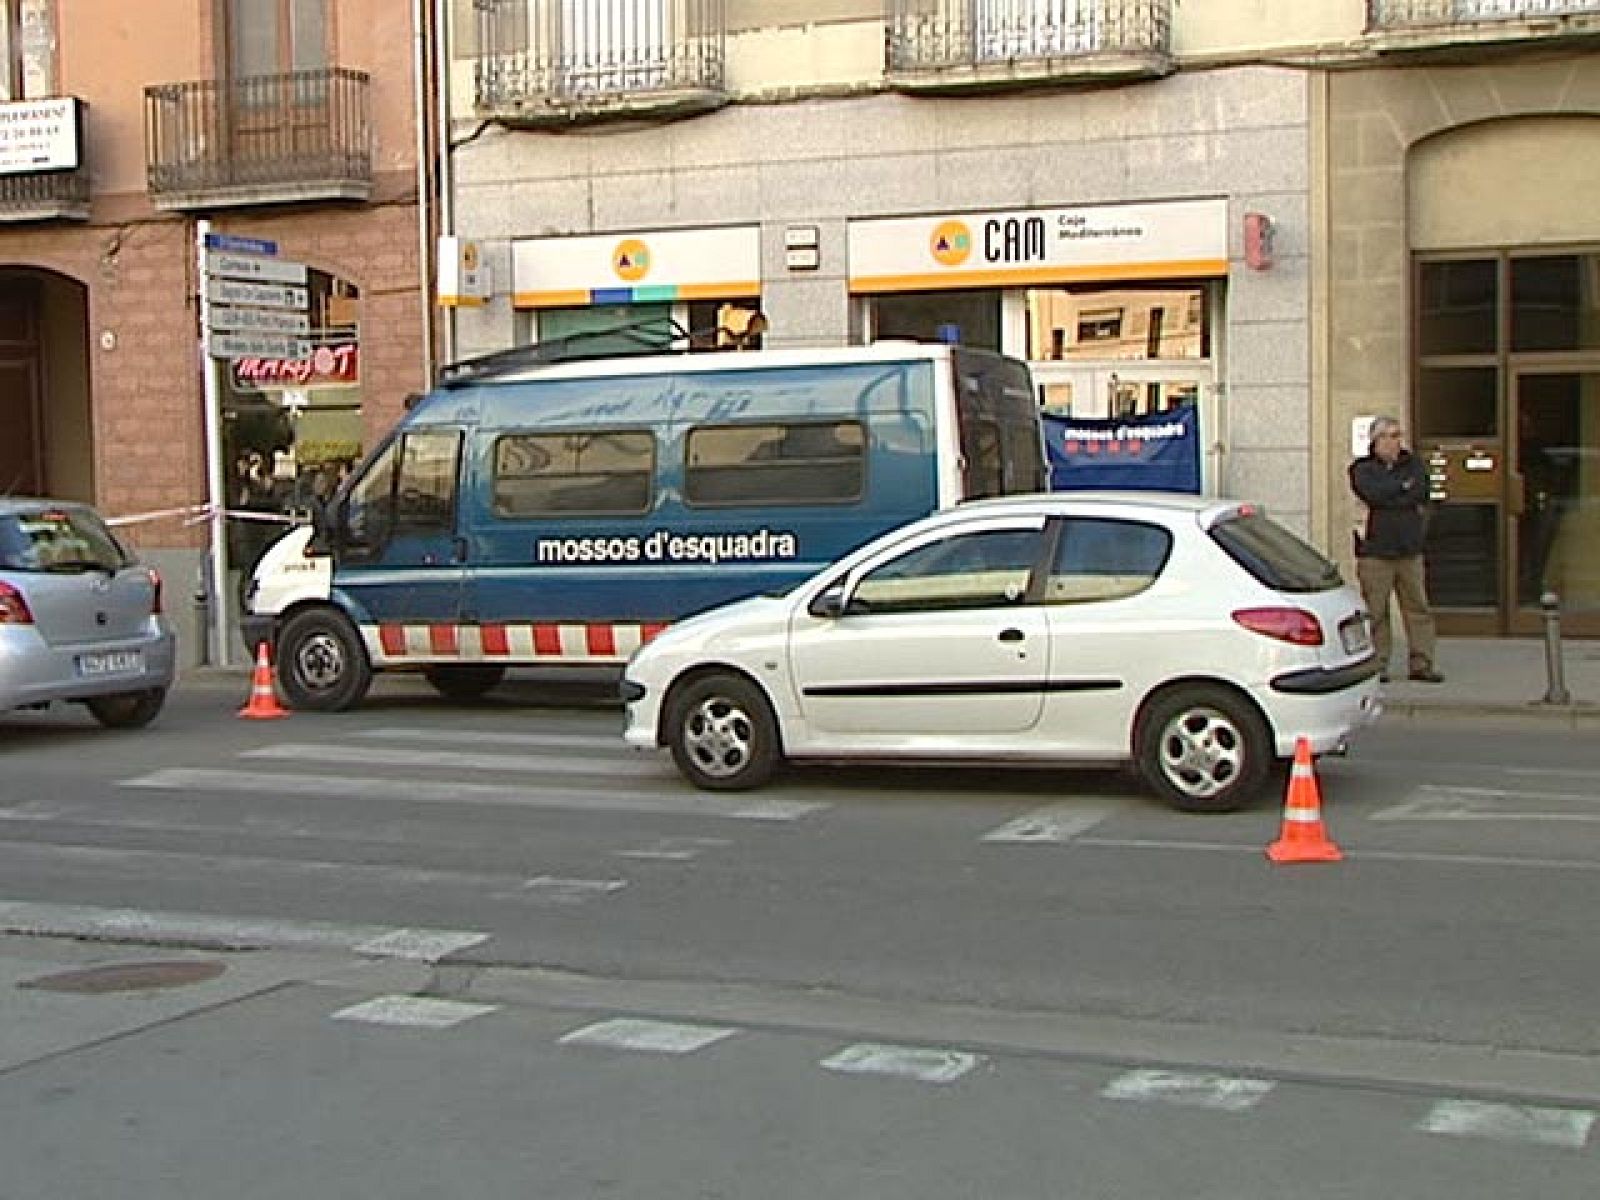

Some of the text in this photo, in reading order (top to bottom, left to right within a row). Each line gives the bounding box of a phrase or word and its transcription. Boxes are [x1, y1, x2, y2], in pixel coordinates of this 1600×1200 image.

[985, 217, 1045, 262] CAM
[538, 529, 797, 564] mossos d'esquadra
